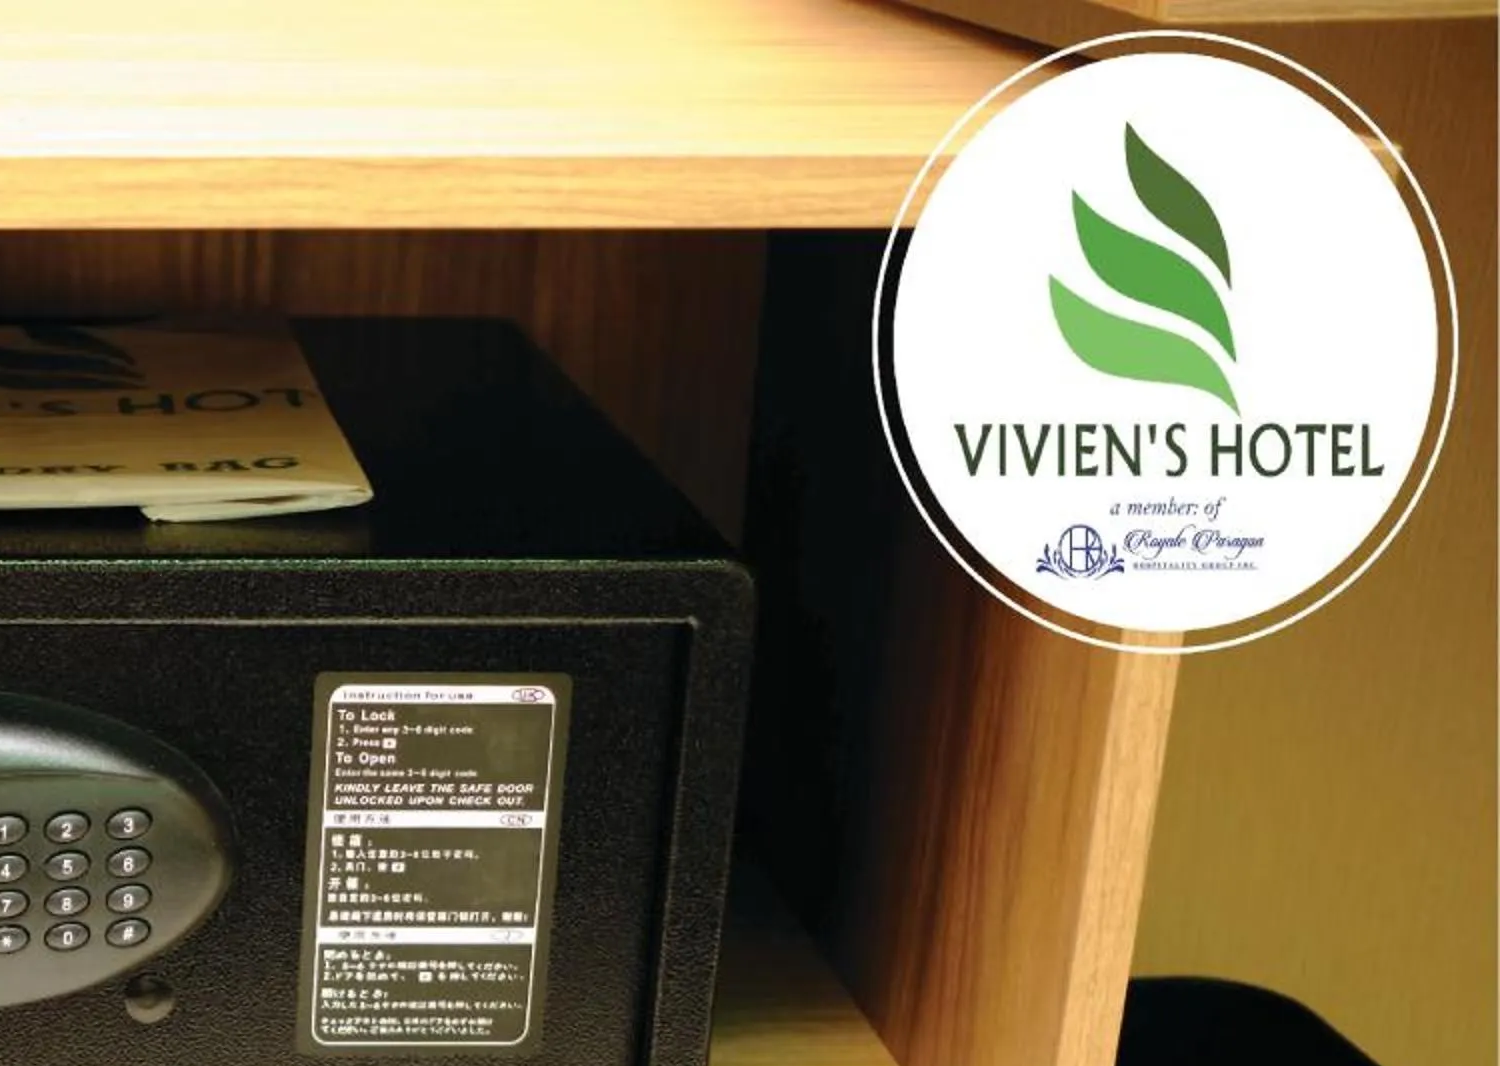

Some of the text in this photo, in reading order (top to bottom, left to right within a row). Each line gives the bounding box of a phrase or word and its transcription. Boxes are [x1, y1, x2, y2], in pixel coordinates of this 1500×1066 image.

[116, 388, 316, 415] HOT
[159, 456, 299, 473] BAG
[336, 709, 396, 721] To Lock
[335, 751, 396, 767] To Open
[334, 783, 535, 793] KINDLY LEAVE THE SAFE DOOR
[334, 795, 403, 806] UNLOCKED
[408, 795, 444, 806] UPON
[448, 795, 492, 806] CHECK
